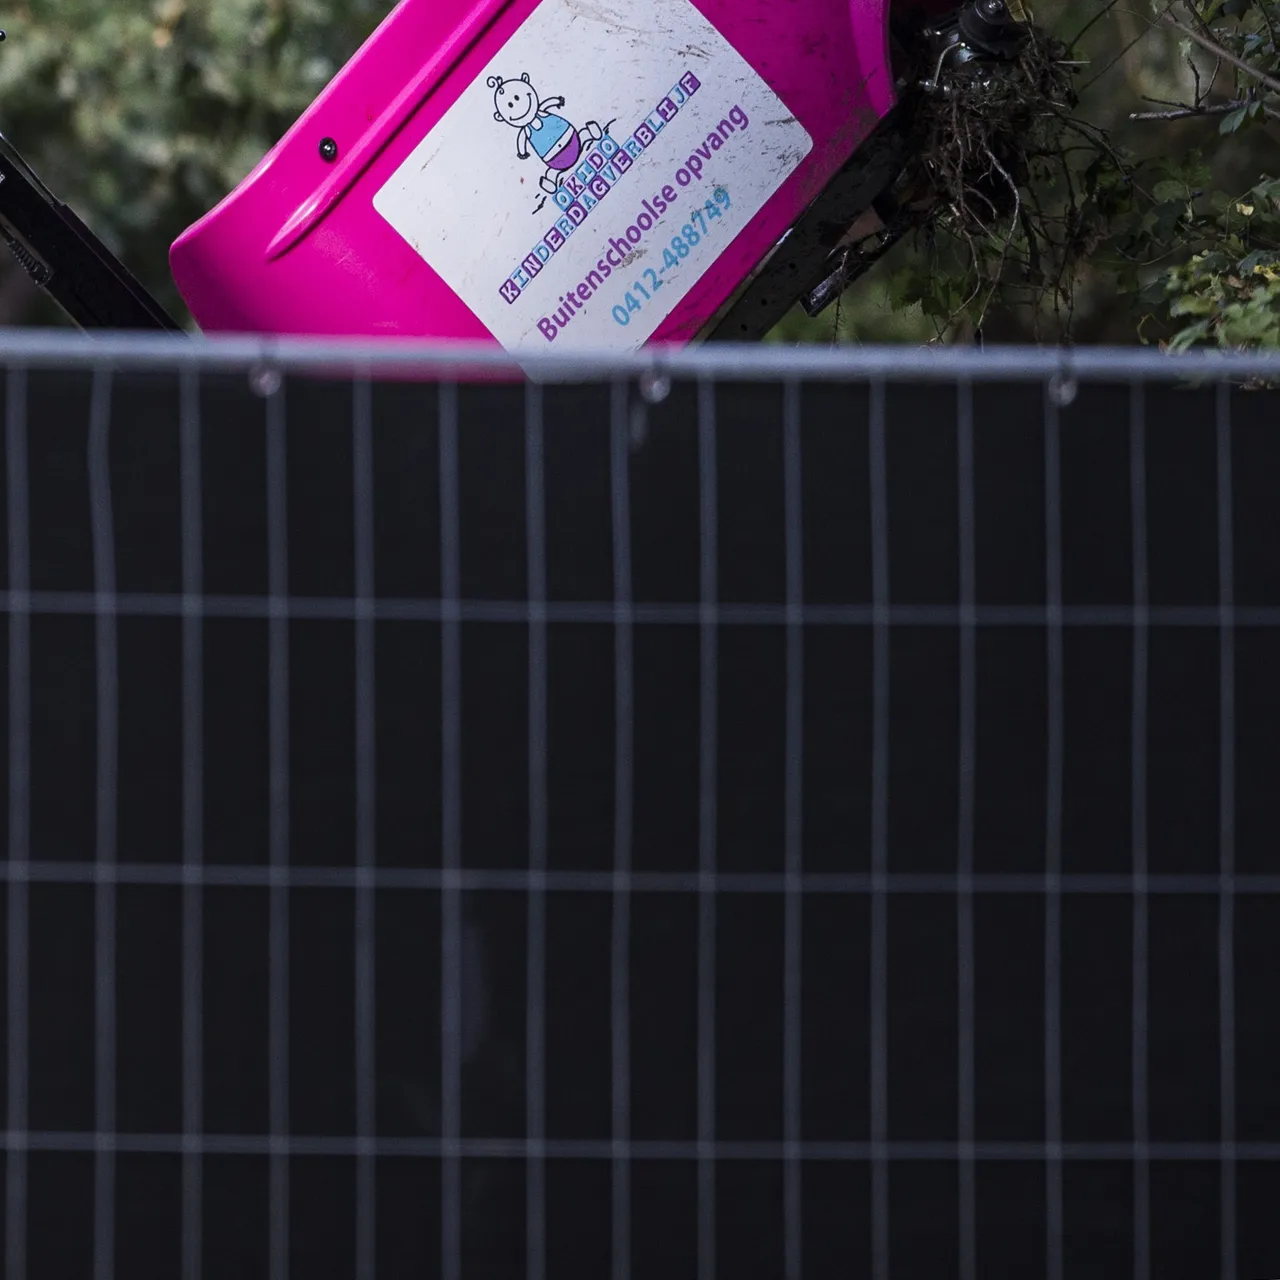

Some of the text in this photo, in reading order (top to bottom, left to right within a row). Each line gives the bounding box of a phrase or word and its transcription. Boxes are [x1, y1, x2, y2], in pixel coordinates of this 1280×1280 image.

[498, 71, 701, 305] KINDERDAGVERBLIJF
[537, 104, 750, 343] Buitenschoolse opvang
[551, 135, 620, 211] OKIDO
[611, 185, 733, 328] 0412-488749
